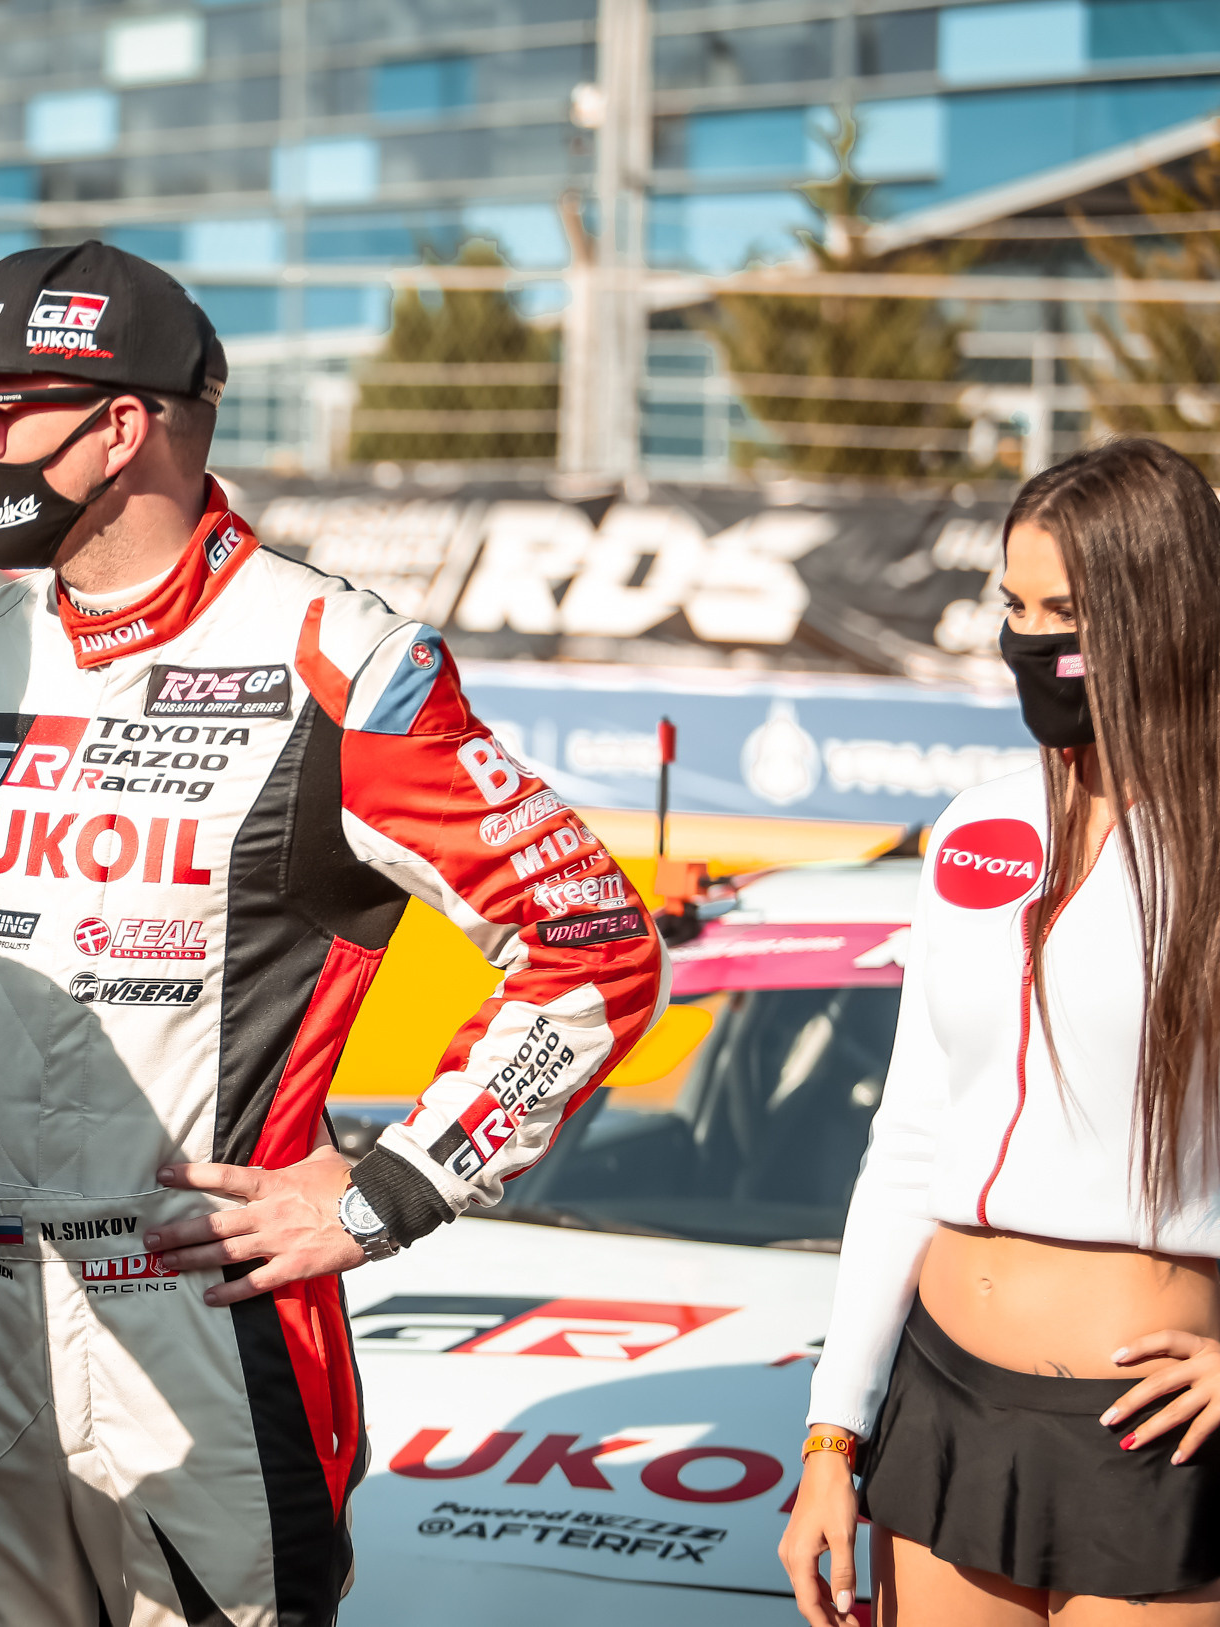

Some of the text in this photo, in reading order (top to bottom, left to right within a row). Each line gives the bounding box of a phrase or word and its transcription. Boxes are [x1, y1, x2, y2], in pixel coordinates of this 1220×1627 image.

[33, 305, 99, 327] GR
[26, 329, 98, 351] LUKOIL
[3, 394, 23, 402] TOYOTA
[208, 526, 242, 570] GR
[457, 504, 832, 643] RDS
[78, 618, 155, 653] LUKOIL
[157, 670, 286, 701] RDS GP
[150, 702, 285, 713] RUSSIAN DRIFT SERIES
[97, 717, 250, 746] TOYOTA
[82, 743, 229, 772] GAZOO
[72, 768, 215, 803] Racing
[941, 848, 1034, 879] TOYOTA
[112, 918, 207, 949] FEAL
[100, 982, 204, 1003] WISEFAB
[486, 1015, 550, 1095] TOYOTA
[499, 1031, 560, 1111] GAZOO
[509, 1045, 575, 1127] Racing
[444, 1107, 516, 1180] GR
[40, 1216, 138, 1242] N.SHIKOV
[86, 1281, 178, 1295] RACING
[380, 1426, 792, 1508] UKO
[417, 1517, 716, 1566] @AFTERFIX
